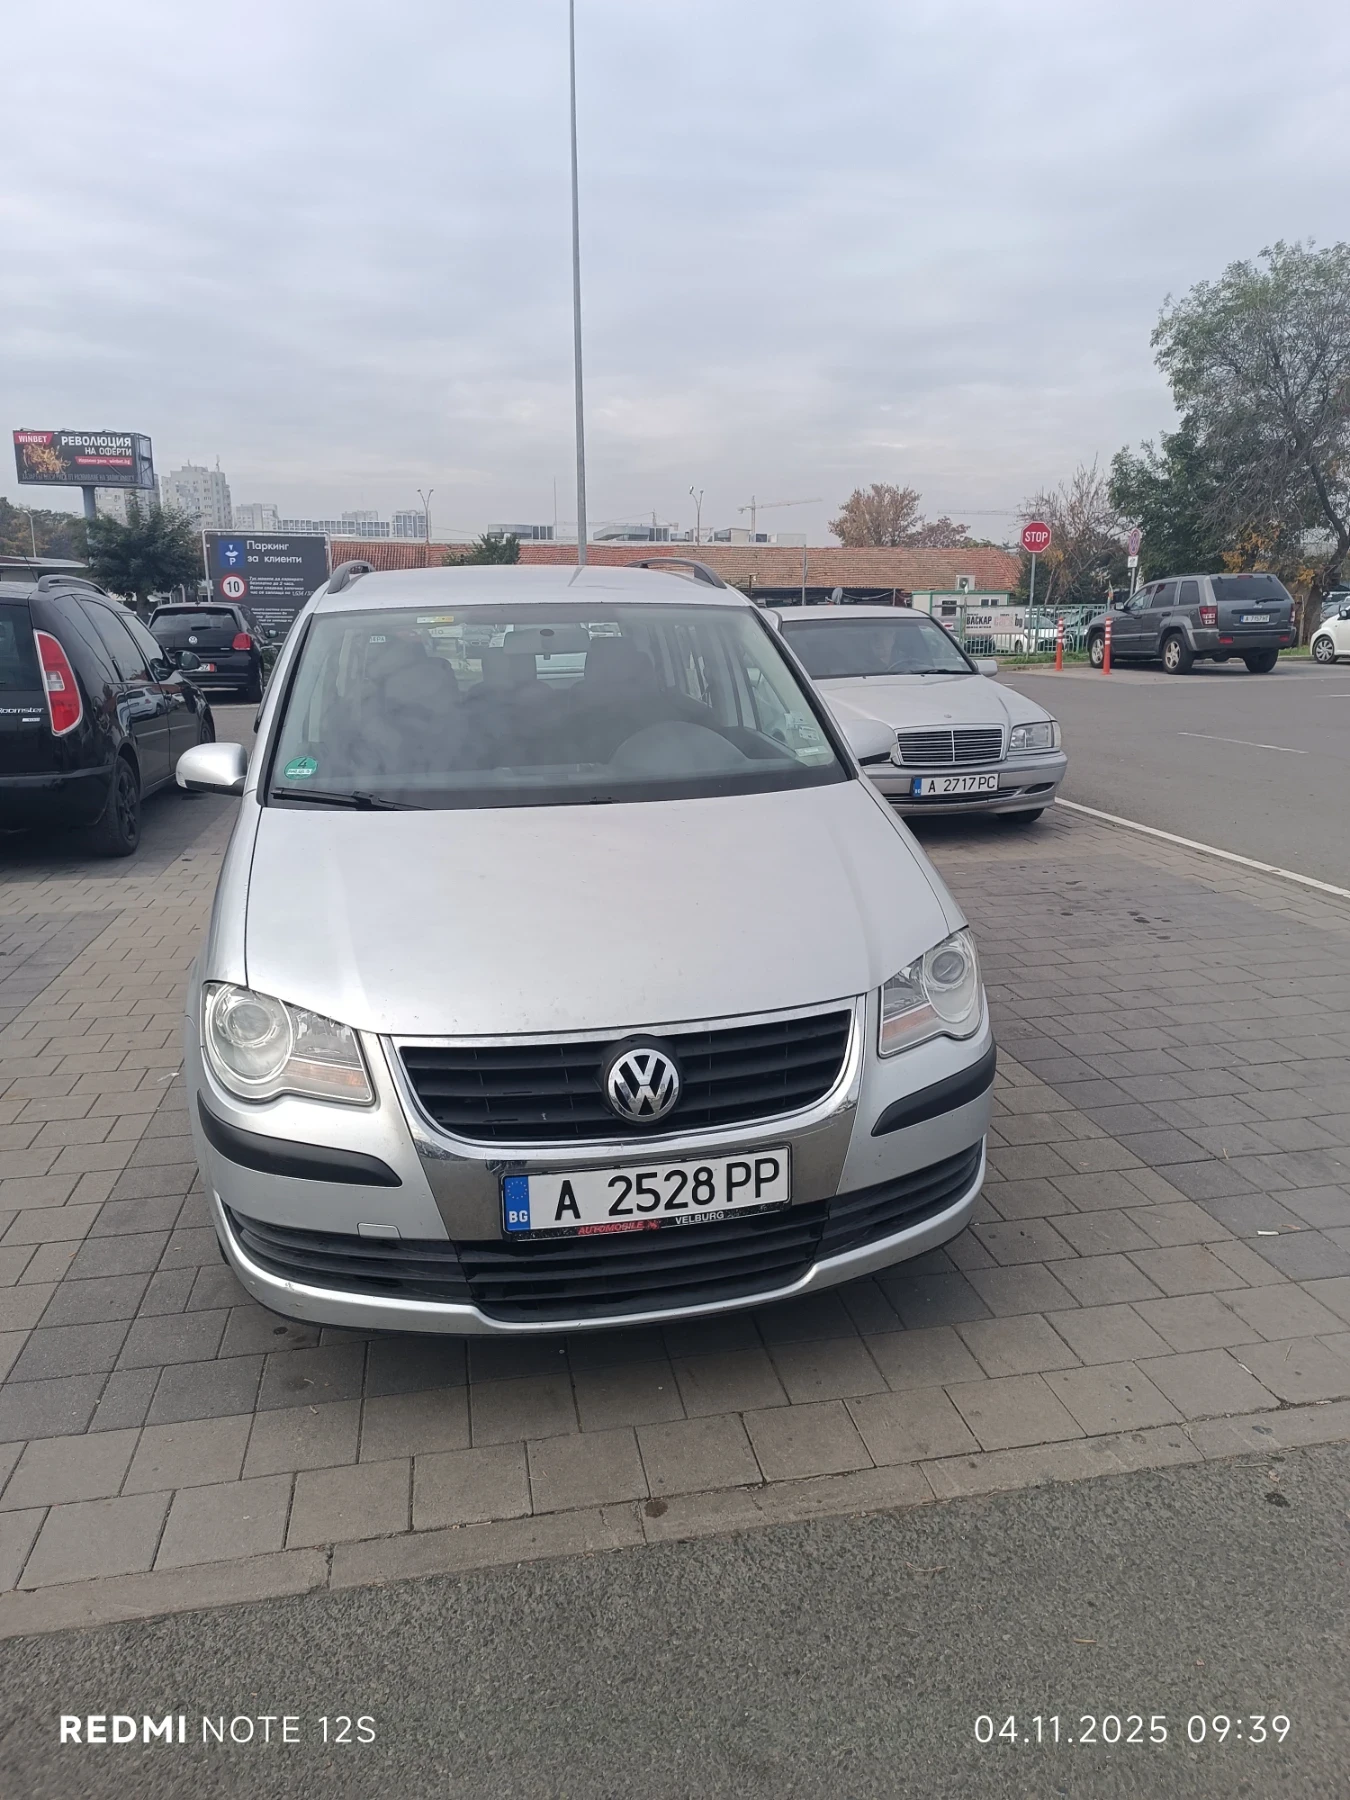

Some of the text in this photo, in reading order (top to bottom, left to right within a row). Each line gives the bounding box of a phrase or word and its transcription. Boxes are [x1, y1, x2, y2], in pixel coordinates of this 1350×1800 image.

[18, 435, 47, 443] WINBET
[61, 436, 132, 448] РЕВОЛЮЦИЯ
[84, 447, 132, 456] НА ОФЕРТИ
[1024, 531, 1049, 543] STOP
[246, 540, 290, 552] Паркинг
[226, 580, 240, 593] 10
[297, 757, 308, 768] 4
[928, 780, 936, 793] A
[555, 1179, 581, 1221] A
[509, 1210, 528, 1224] BG
[578, 1220, 644, 1236] AUTOMOBILE
[675, 1210, 725, 1225] VELBURG
